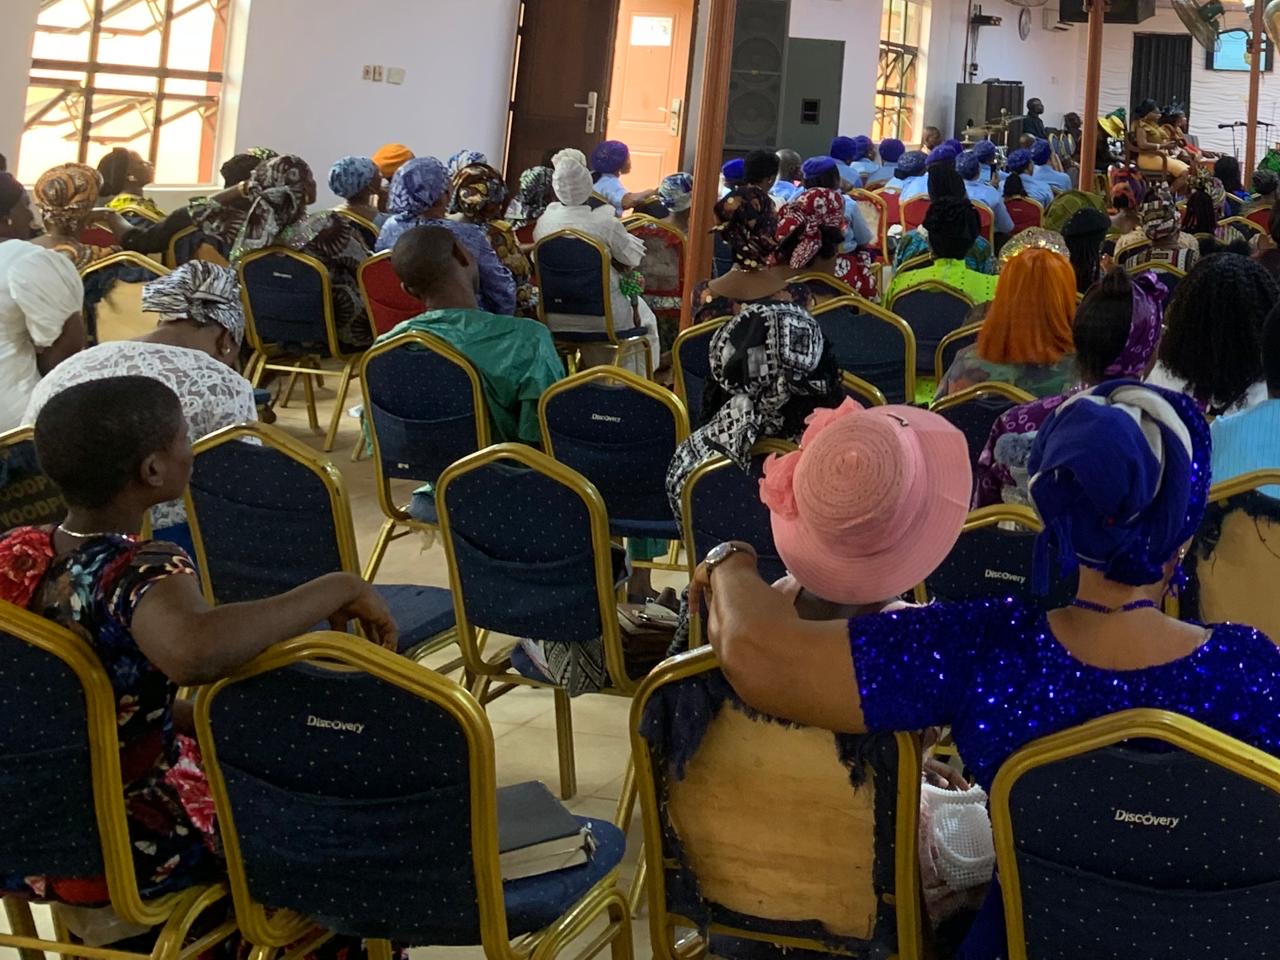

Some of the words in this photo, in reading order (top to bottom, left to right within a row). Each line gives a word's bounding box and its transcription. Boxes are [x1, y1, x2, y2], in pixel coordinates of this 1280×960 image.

[984, 568, 1027, 585] Discovery
[306, 714, 366, 735] Discovery
[1113, 808, 1180, 829] Discovery
